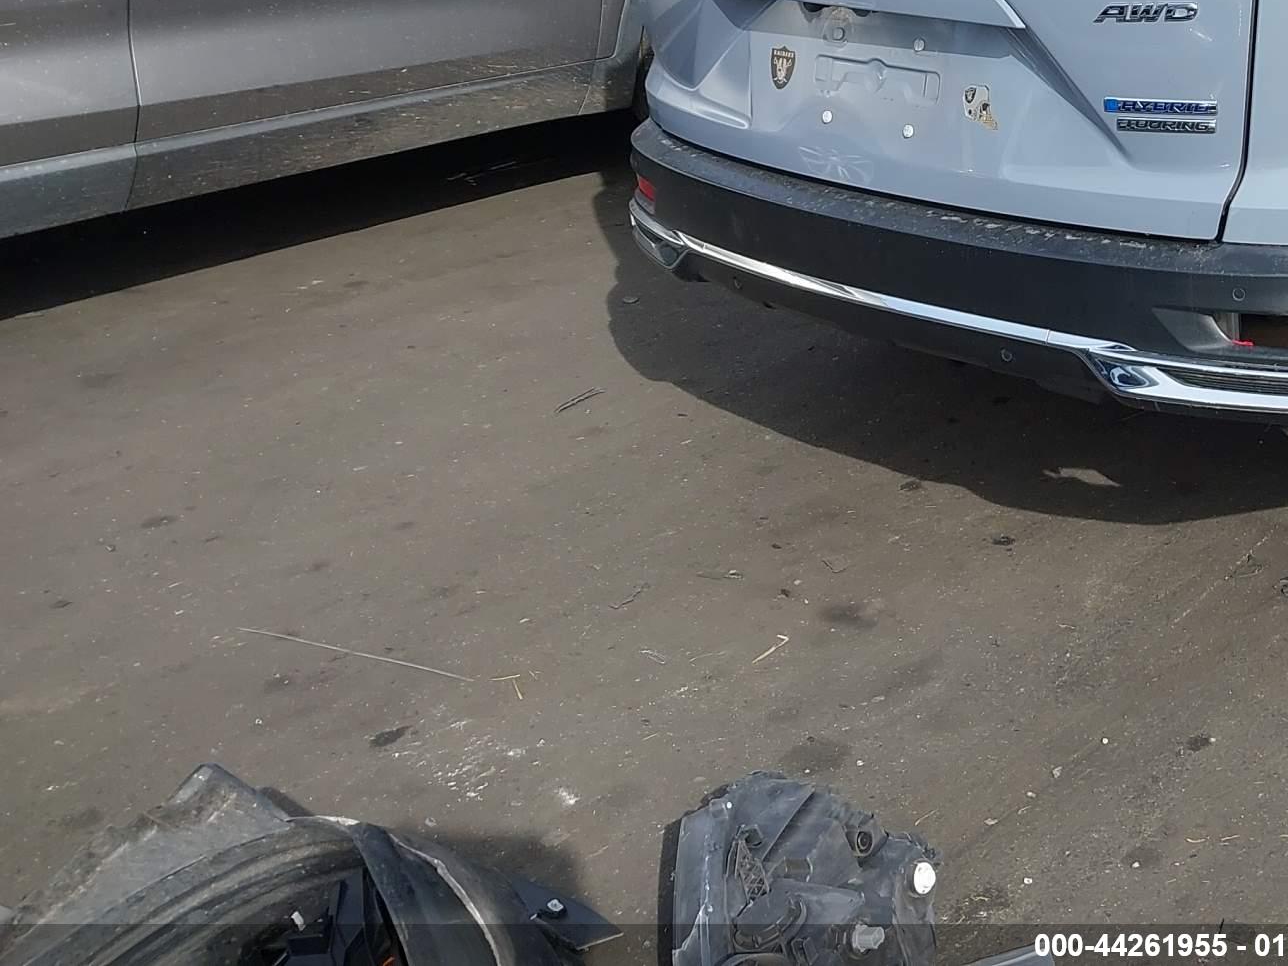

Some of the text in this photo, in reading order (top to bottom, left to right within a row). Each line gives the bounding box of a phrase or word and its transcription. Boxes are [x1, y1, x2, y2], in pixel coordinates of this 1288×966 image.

[1093, 1, 1198, 23] AWD
[1118, 100, 1212, 114] HYBRID
[1118, 118, 1211, 132] TOURING
